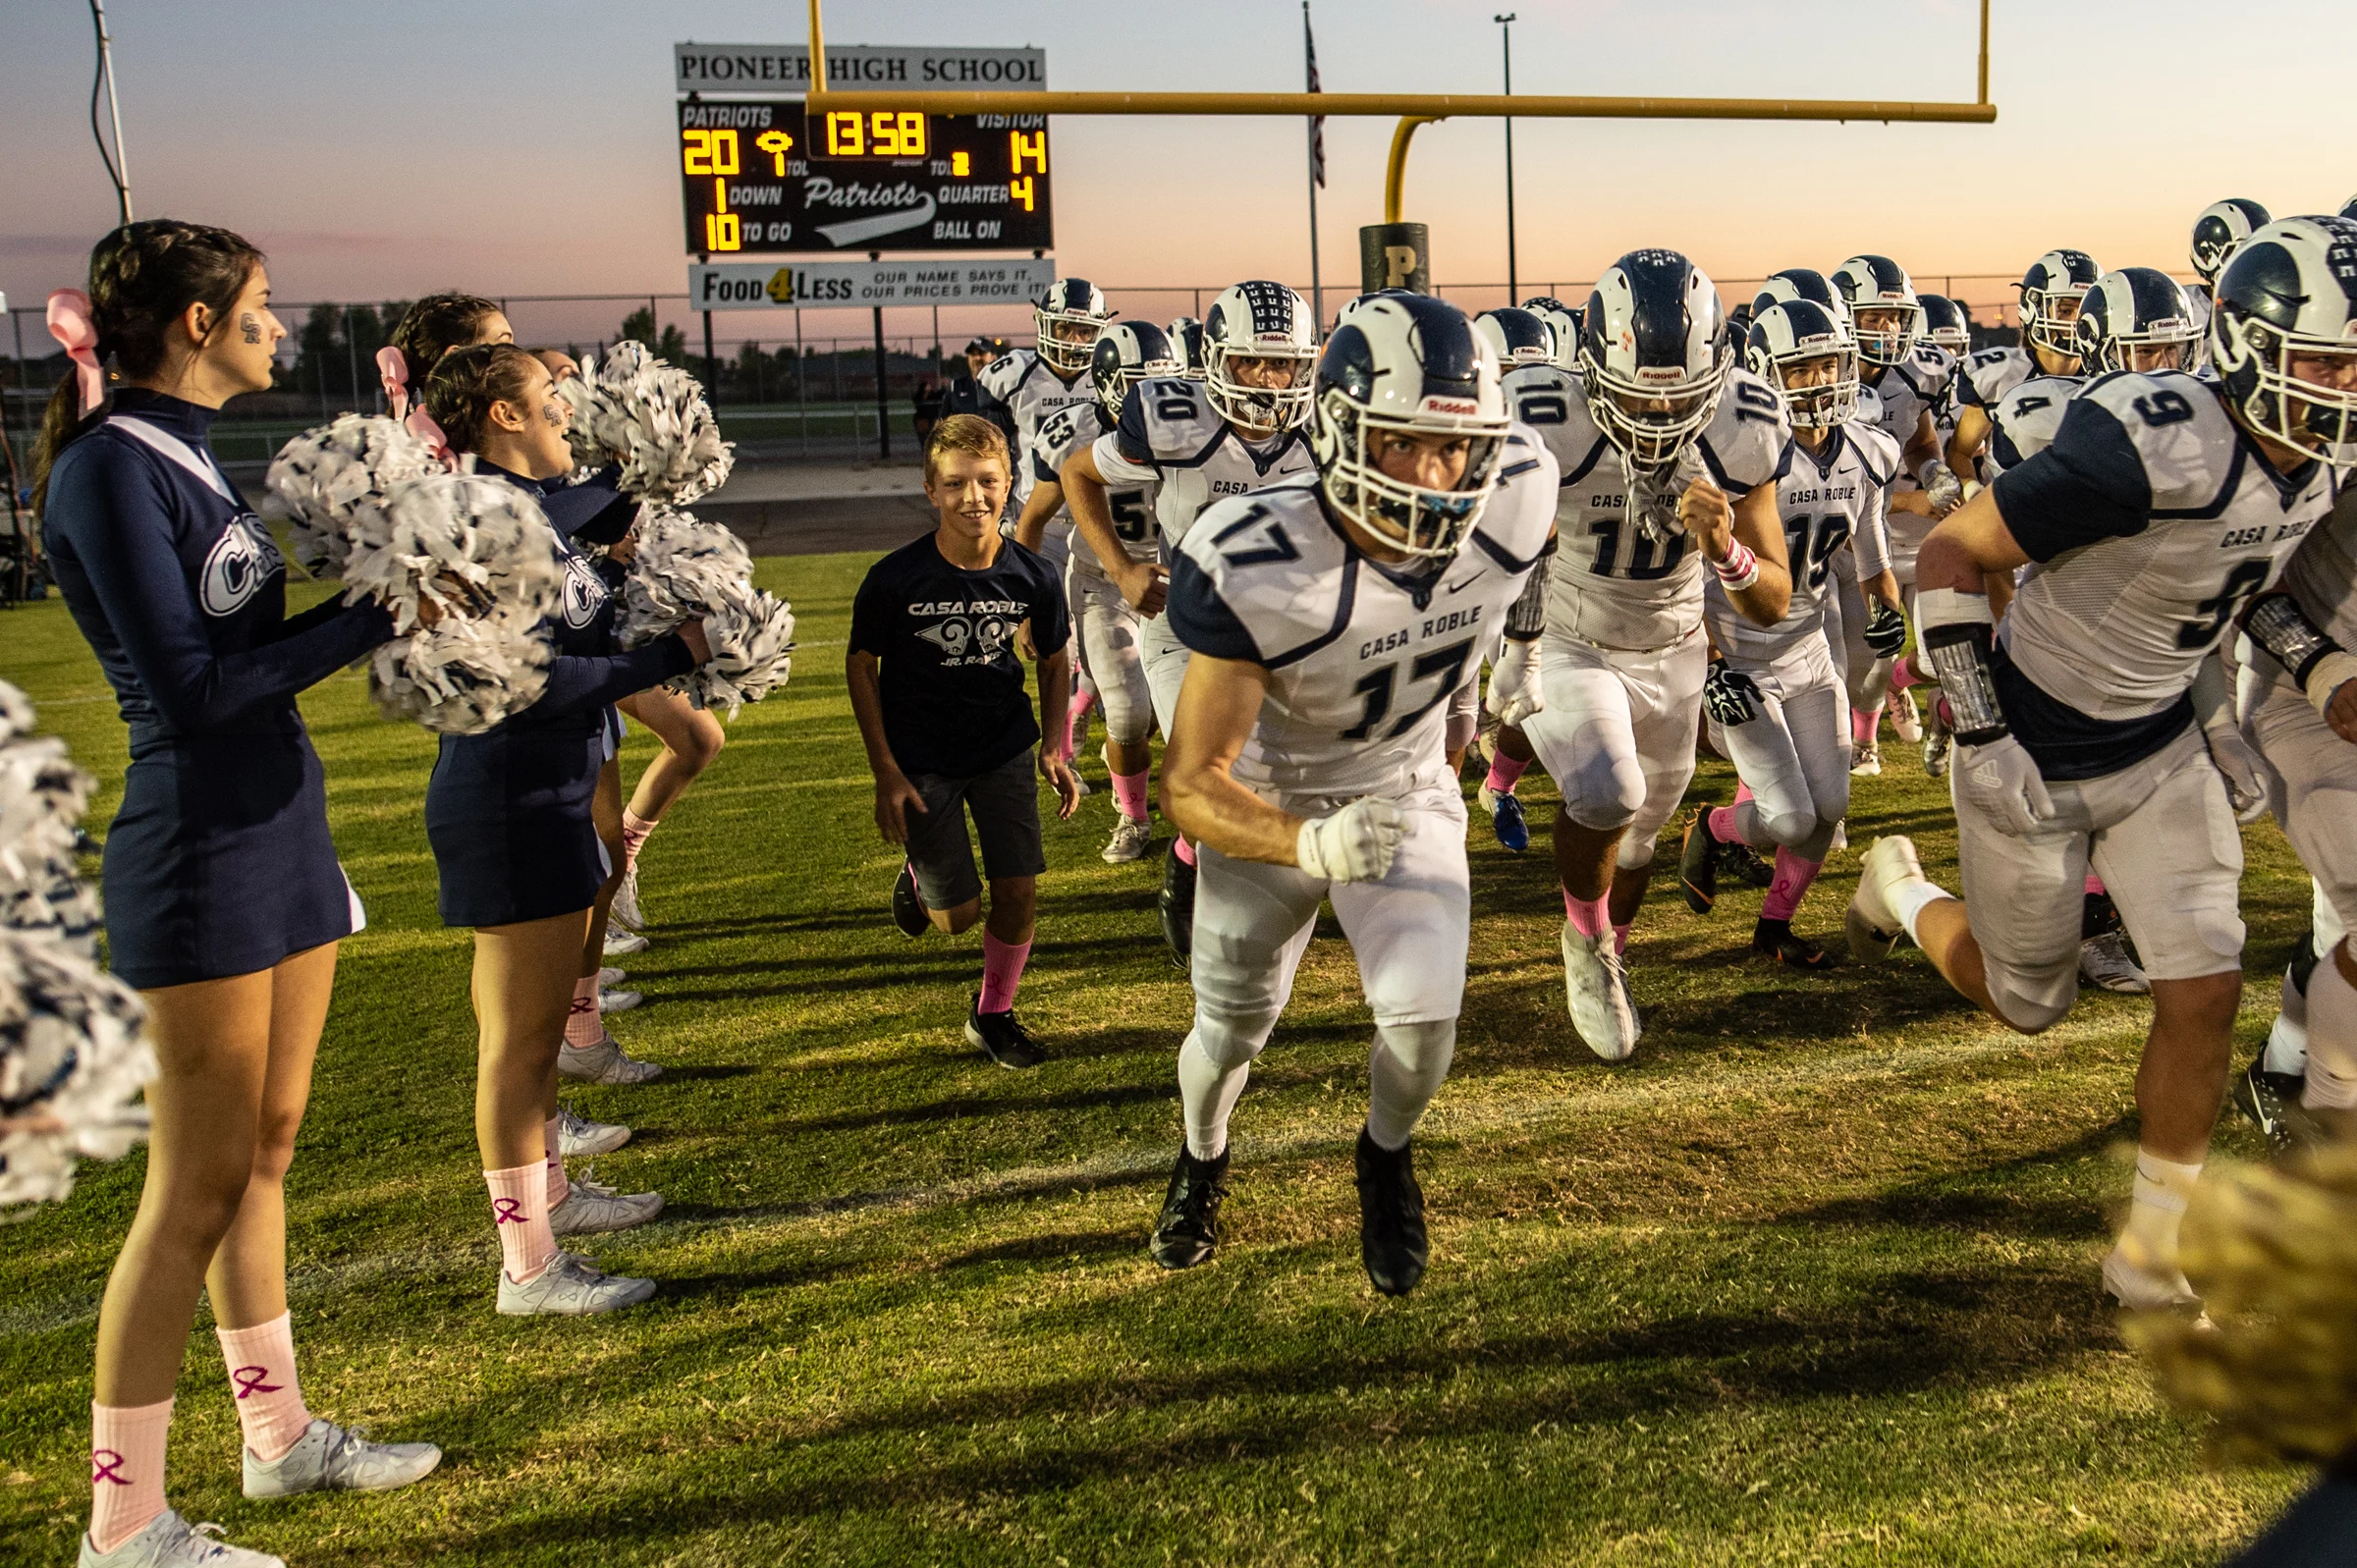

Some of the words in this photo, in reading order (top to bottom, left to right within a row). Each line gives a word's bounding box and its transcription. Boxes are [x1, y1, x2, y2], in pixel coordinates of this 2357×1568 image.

[682, 54, 811, 81] PIONEER
[830, 57, 907, 81] HIGH
[923, 58, 1042, 81] SCHOOL
[683, 106, 773, 128] PATRIOTS
[976, 113, 1044, 129] VISITOR
[826, 111, 925, 155] 13:58
[683, 130, 740, 175] 20
[1010, 131, 1046, 174] 14
[787, 160, 809, 177] TOL
[930, 159, 953, 176] TOL
[715, 177, 727, 213] 1
[729, 186, 783, 205] DOWN
[803, 176, 917, 209] Patriots
[938, 185, 1010, 204] QUARTER
[1011, 176, 1034, 211] 4
[706, 213, 740, 250] 10
[741, 222, 762, 242] TO
[767, 222, 792, 242] GO
[933, 220, 971, 240] BALL
[976, 220, 1002, 239] ON
[874, 271, 907, 284] OUR
[916, 270, 960, 283] NAME
[968, 269, 1007, 282] SAYS
[1014, 268, 1032, 282] IT,
[1385, 245, 1417, 288] P
[766, 267, 795, 303] 4
[861, 285, 896, 298] OUR
[904, 284, 961, 297] PRICES
[970, 282, 1023, 297] PROVE
[1028, 282, 1047, 295] IT!
[990, 356, 1014, 374] 6
[1973, 351, 2007, 369] 2
[1642, 371, 1680, 381] Riddell
[1042, 397, 1065, 406] CASA
[1153, 380, 1199, 420] 20
[1427, 399, 1476, 415] Riddell
[1516, 379, 1567, 424] 10
[1735, 381, 1780, 426] 10
[2013, 396, 2053, 420] 4
[2132, 391, 2196, 428] 9
[1043, 410, 1077, 451] 53
[1213, 480, 1248, 495] CASA
[1789, 488, 1819, 505] CASA
[1824, 487, 1856, 501] ROBLE
[1210, 502, 1301, 568] 17
[1589, 517, 1688, 580] 10
[1784, 513, 1851, 593] 19
[907, 600, 964, 616] CASA
[968, 600, 1028, 616] ROBLE
[1359, 628, 1409, 661] CASA
[1422, 605, 1483, 638] ROBLE
[1339, 634, 1477, 743] 17
